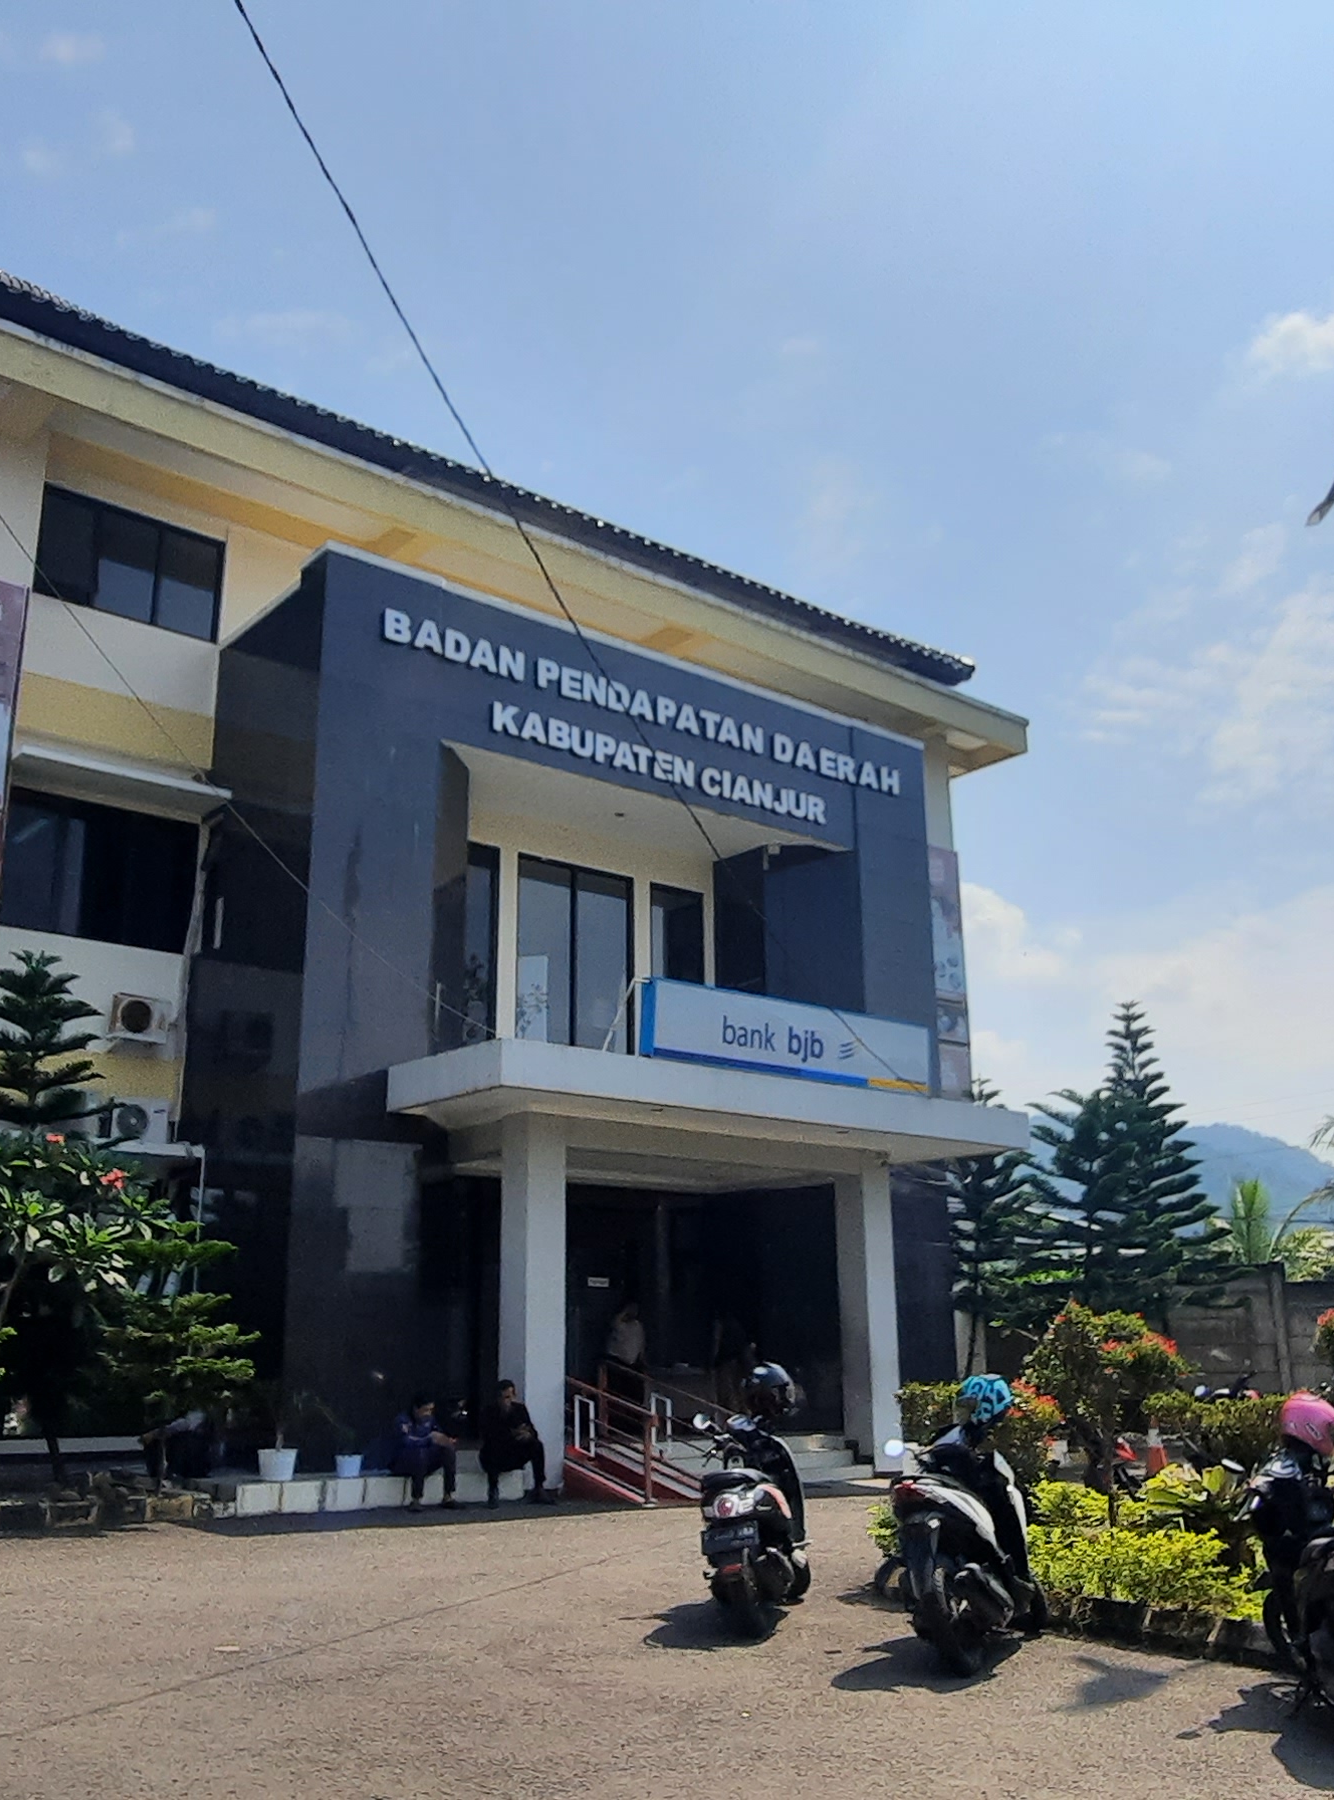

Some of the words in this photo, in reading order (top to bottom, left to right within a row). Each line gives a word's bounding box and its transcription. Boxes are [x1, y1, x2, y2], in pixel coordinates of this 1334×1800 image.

[383, 607, 525, 681] BADAN
[537, 657, 765, 754] PENDAPATAN
[773, 732, 901, 796] DAERAH
[491, 701, 696, 788] KABUPATEN
[701, 767, 827, 825] CIANJUR
[722, 1015, 775, 1052] bank
[788, 1026, 824, 1063] bjb
